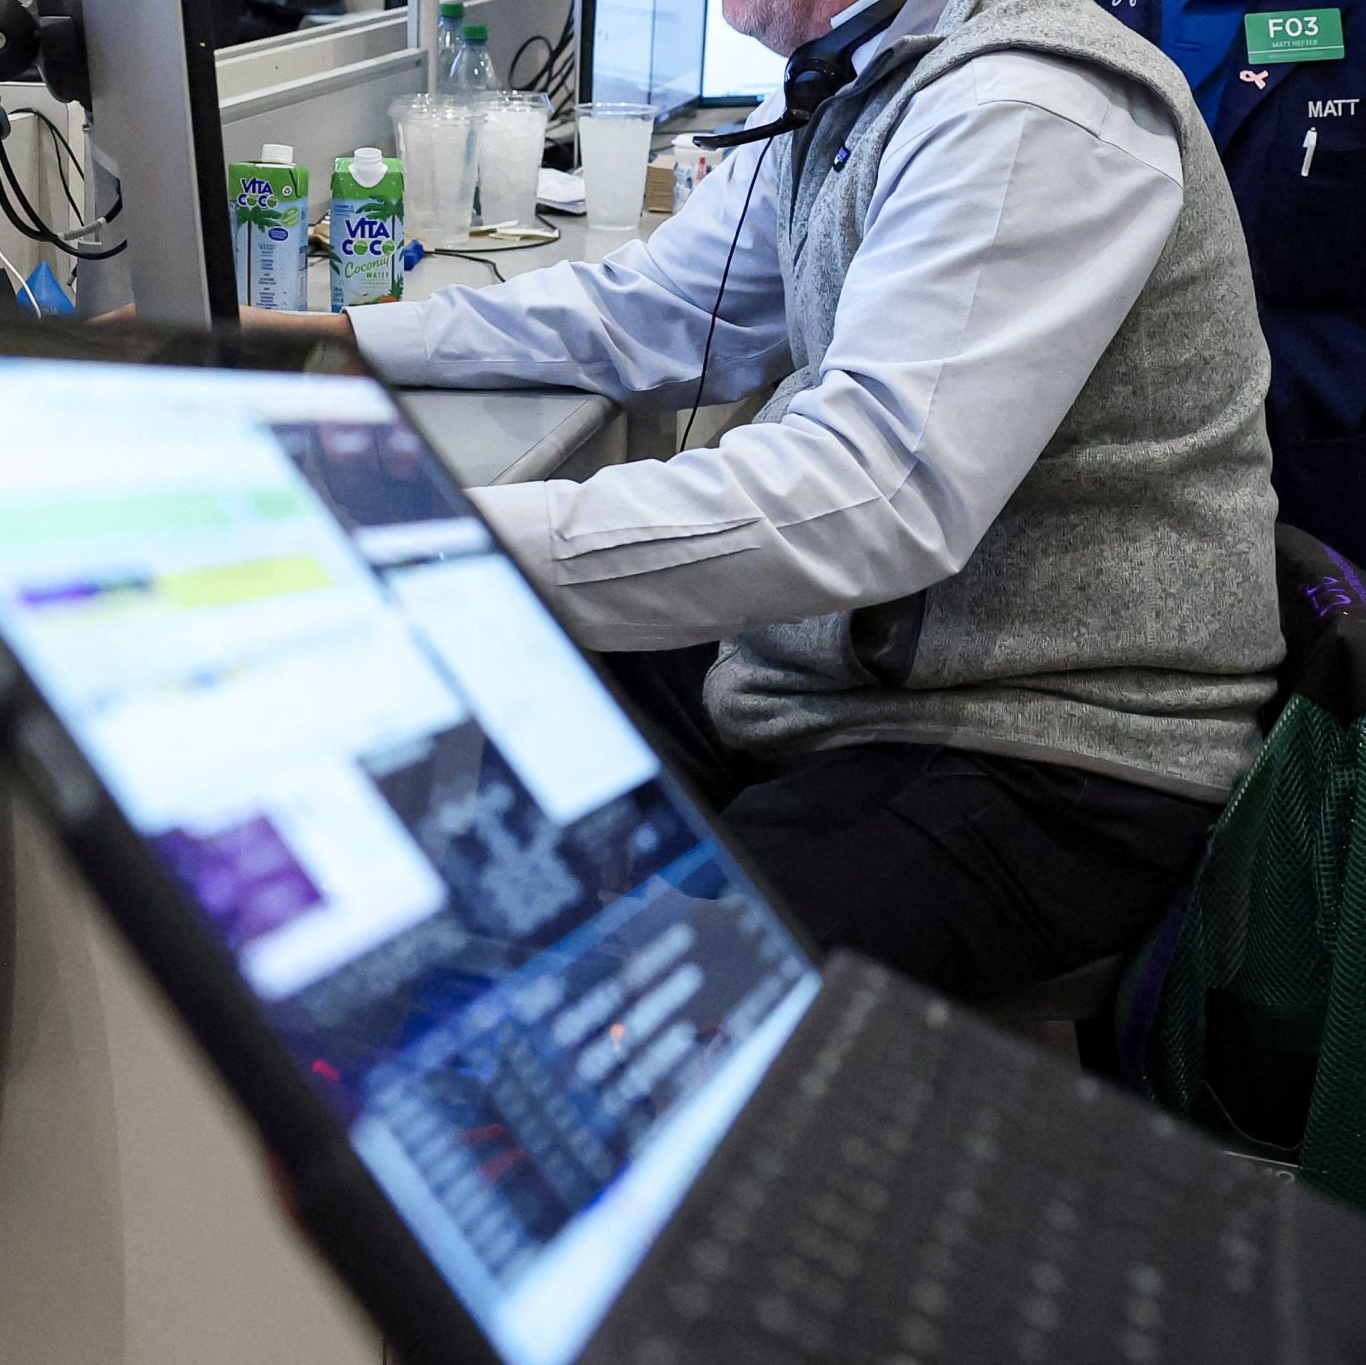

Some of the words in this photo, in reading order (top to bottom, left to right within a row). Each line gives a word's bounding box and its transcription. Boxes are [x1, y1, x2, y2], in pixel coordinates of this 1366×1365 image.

[1307, 98, 1360, 118] MATT
[241, 178, 274, 195] VITA
[237, 193, 278, 208] COCO
[345, 217, 391, 238] VITA
[341, 239, 396, 256] COCO
[344, 256, 391, 279] Coconut
[366, 271, 390, 279] WATER
